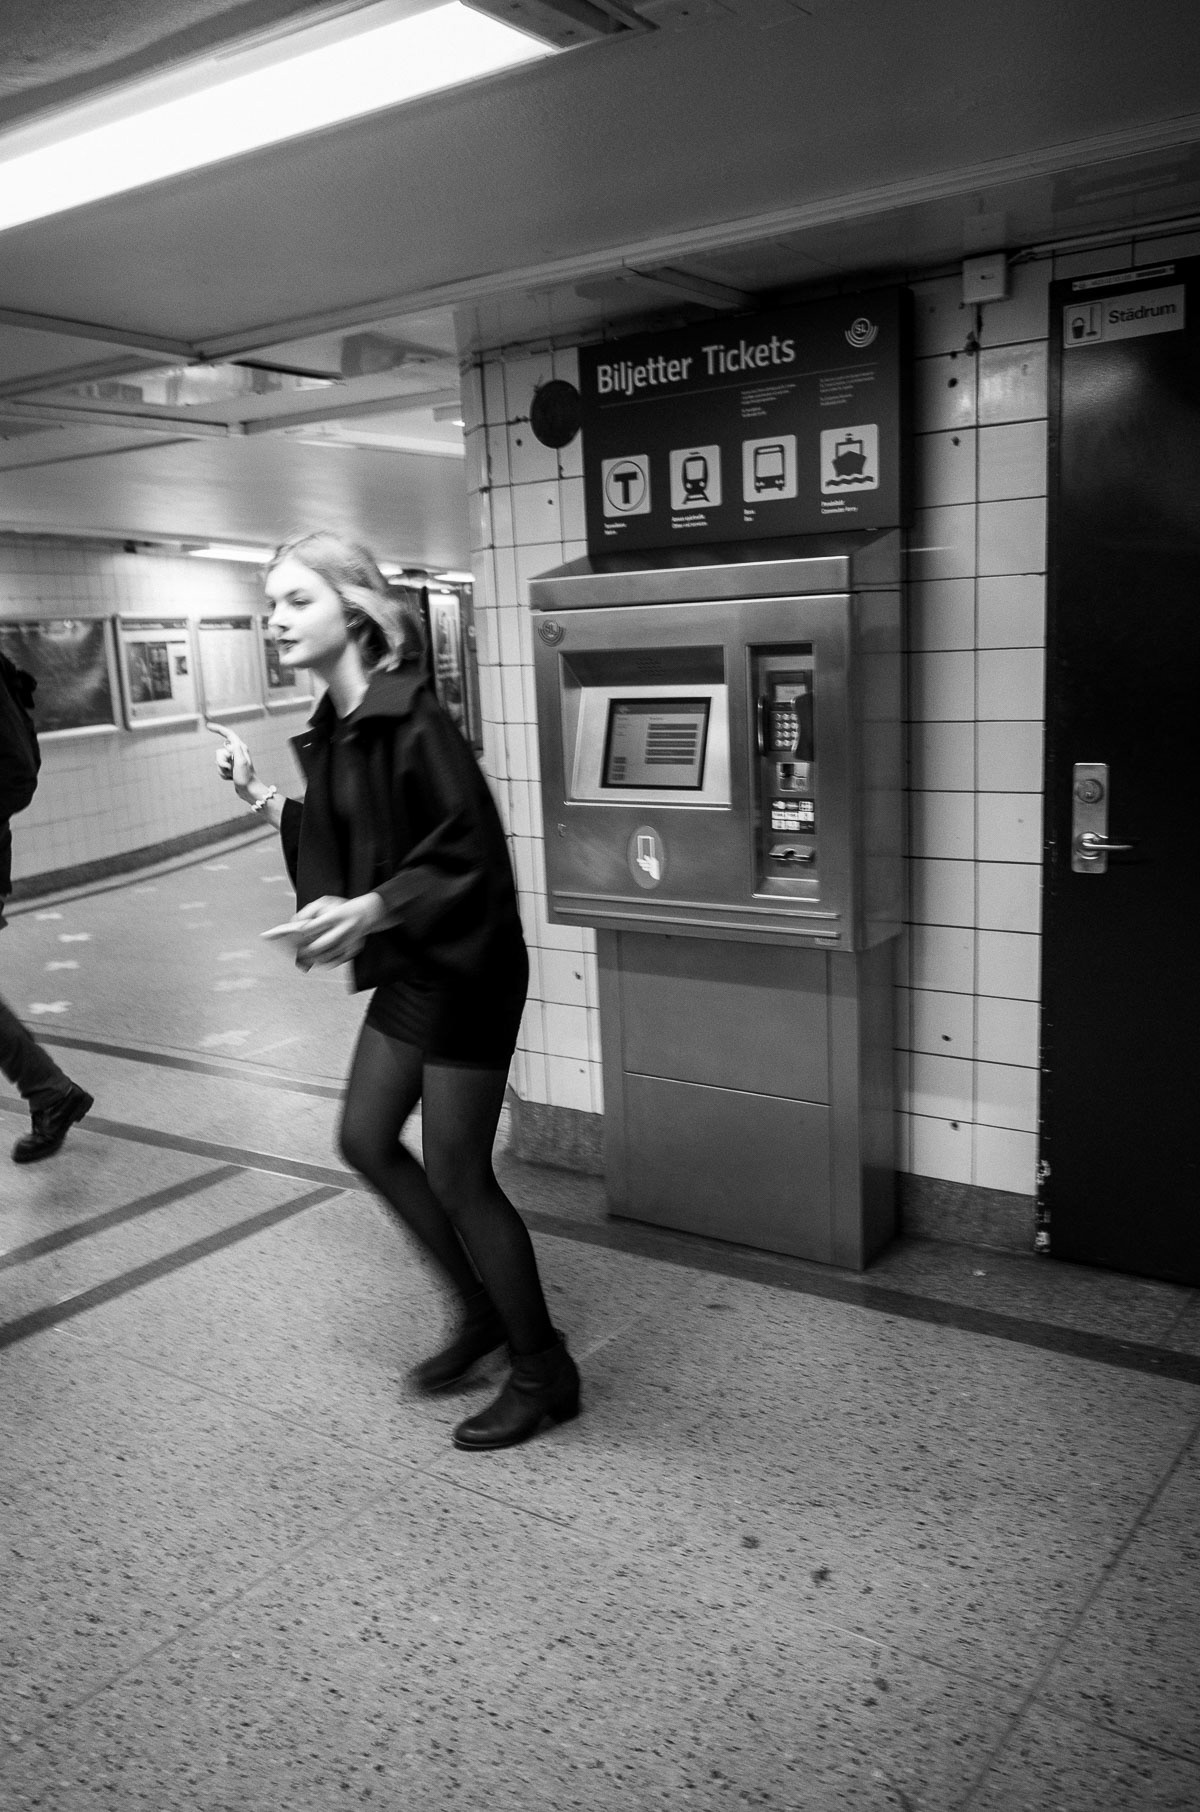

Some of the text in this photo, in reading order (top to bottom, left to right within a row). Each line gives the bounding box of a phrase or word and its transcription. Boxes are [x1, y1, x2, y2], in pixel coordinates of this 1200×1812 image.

[1108, 303, 1176, 324] Städrum
[597, 355, 693, 396] Biljetter
[702, 335, 796, 375] Tickets
[613, 471, 638, 505] T
